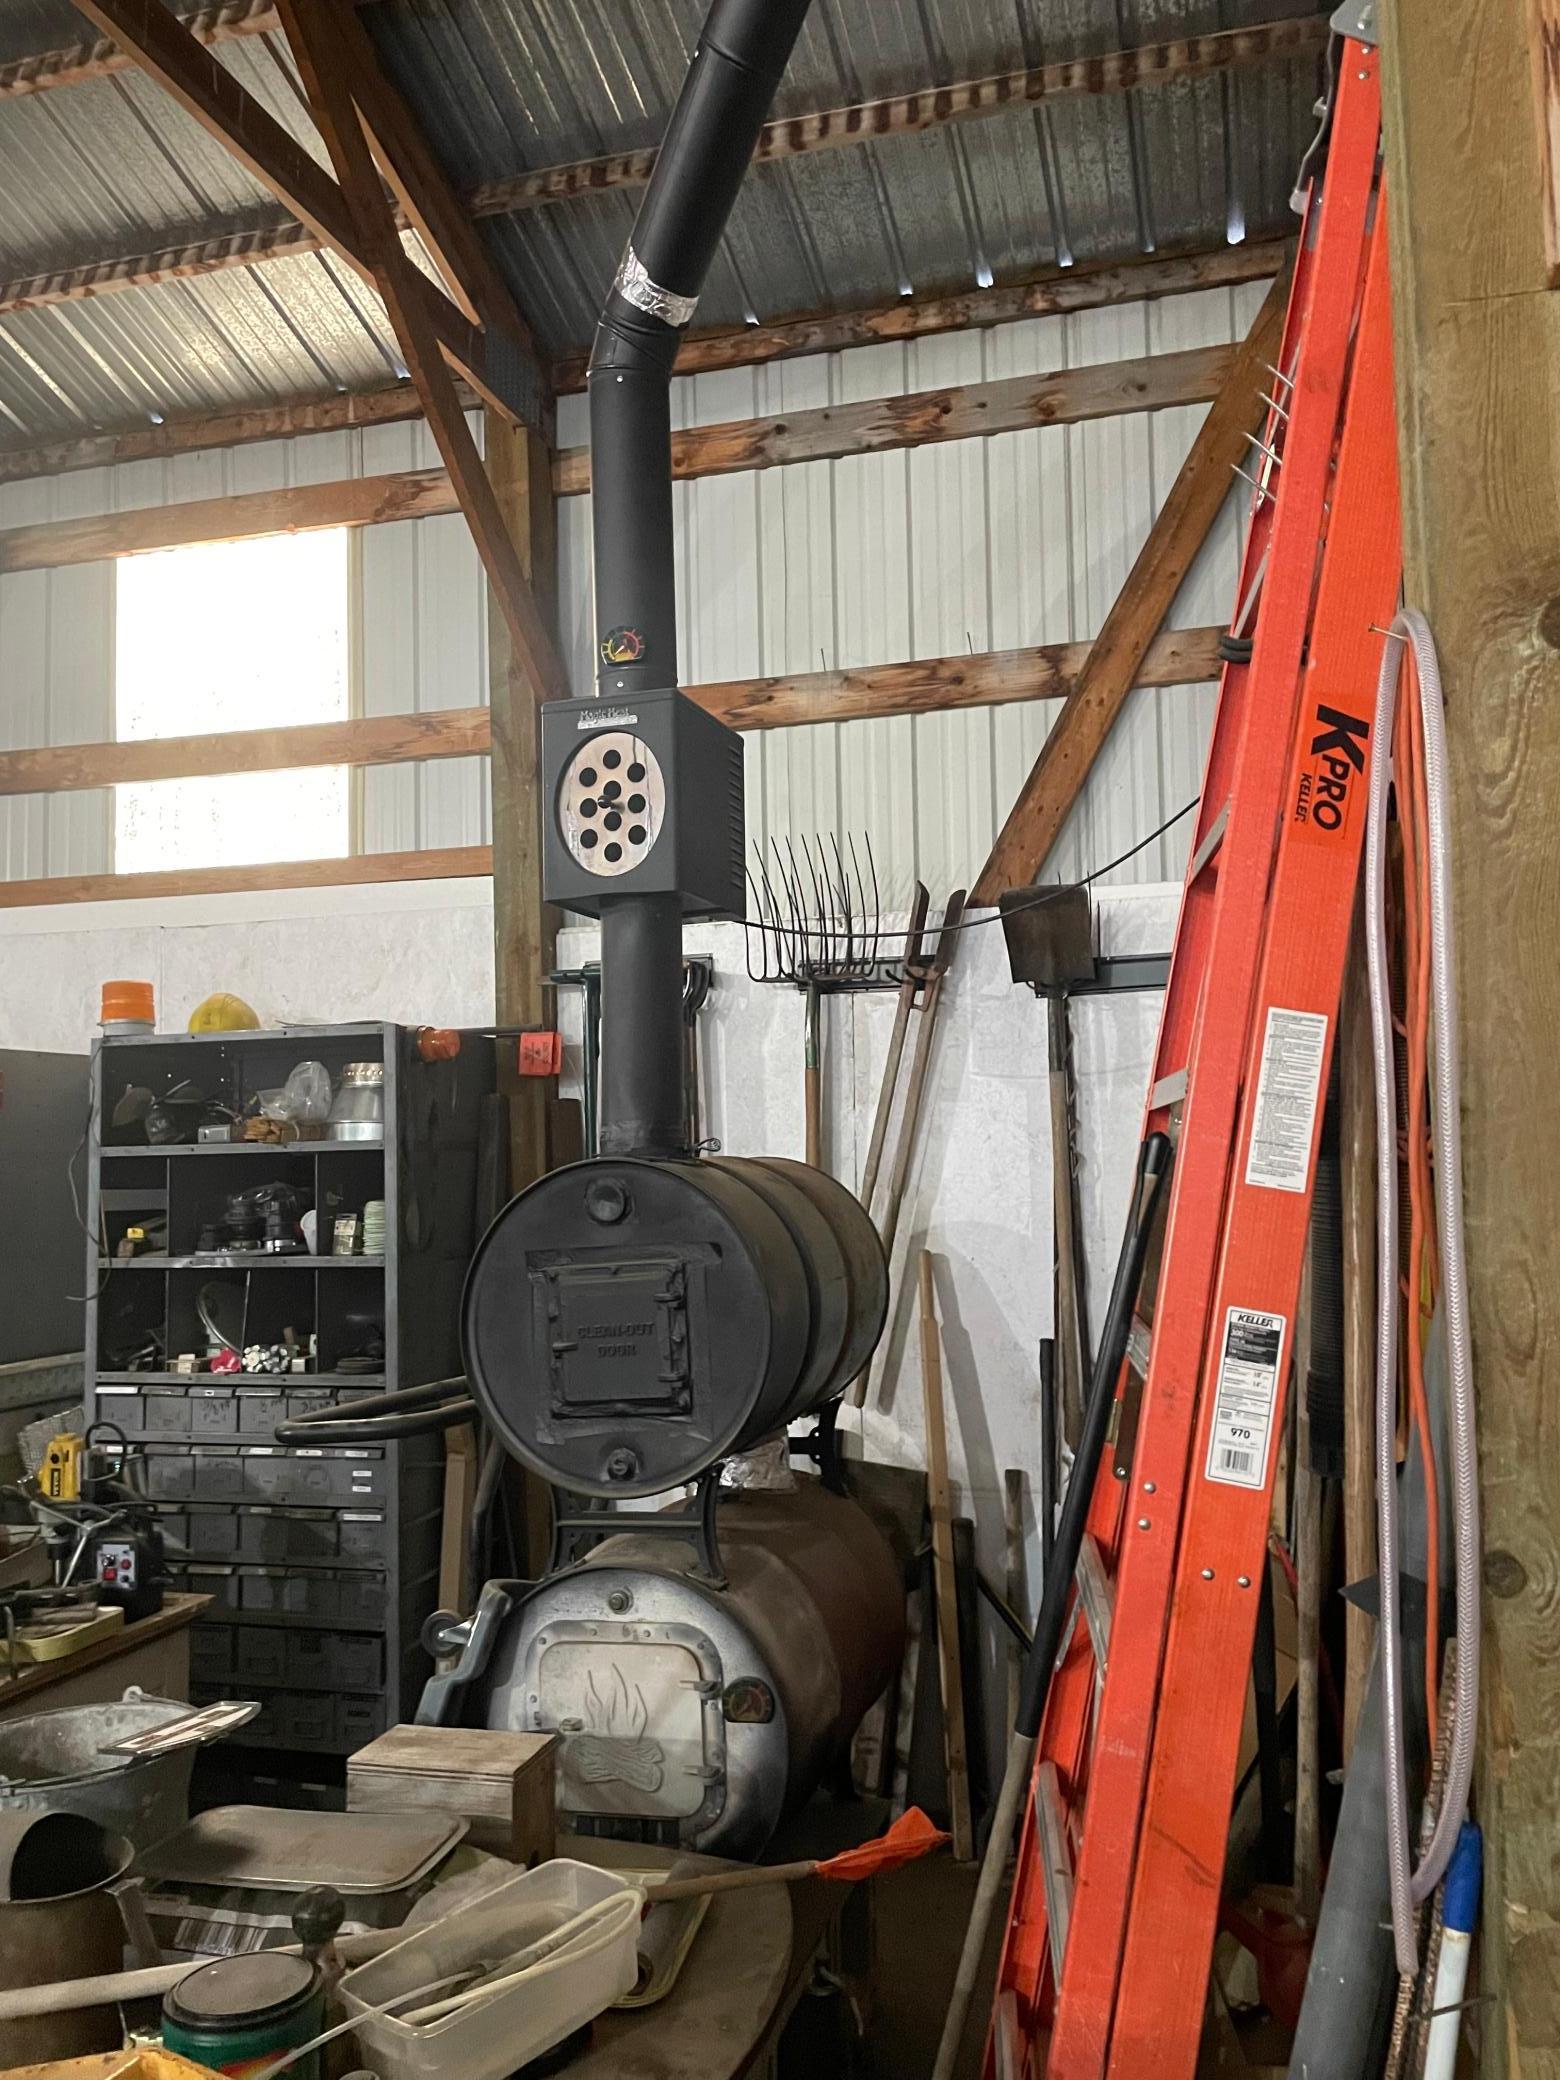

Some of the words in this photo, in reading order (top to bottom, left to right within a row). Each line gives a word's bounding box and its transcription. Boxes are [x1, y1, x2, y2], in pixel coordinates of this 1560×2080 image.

[1295, 773, 1312, 824] KELLER
[1237, 1314, 1274, 1328] KELLER
[1231, 1427, 1251, 1439] 970
